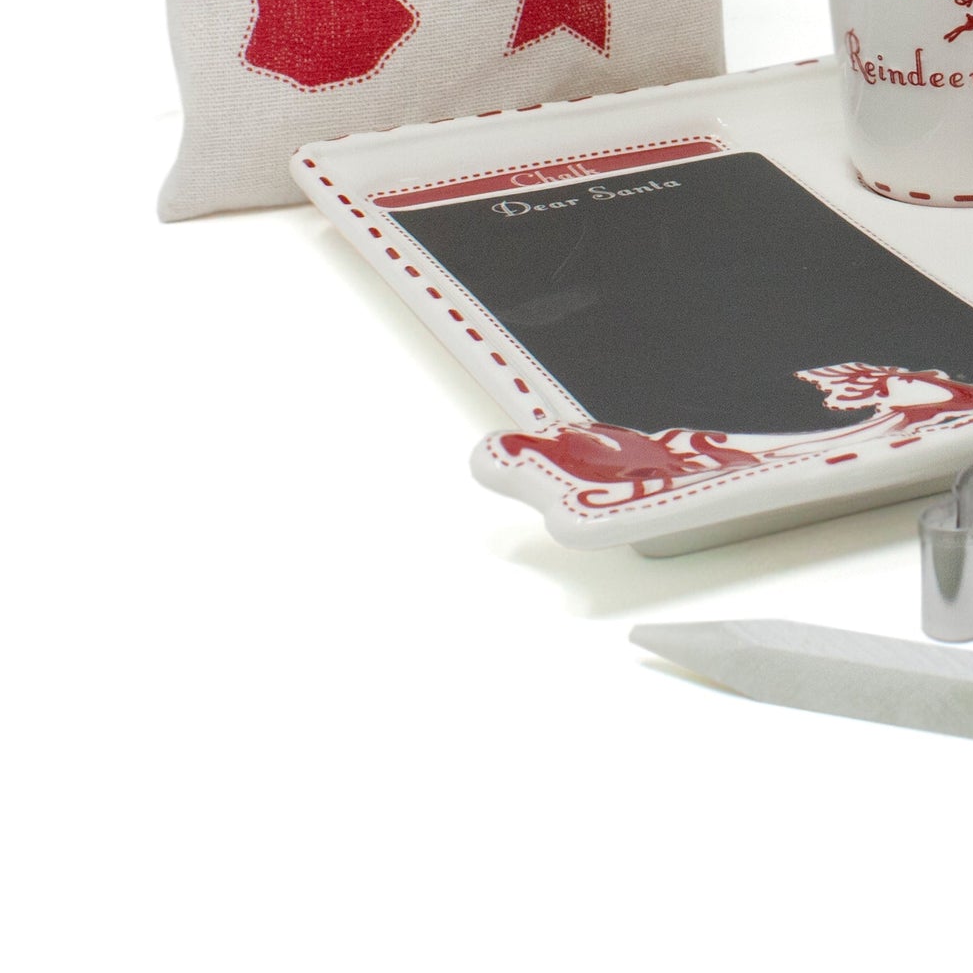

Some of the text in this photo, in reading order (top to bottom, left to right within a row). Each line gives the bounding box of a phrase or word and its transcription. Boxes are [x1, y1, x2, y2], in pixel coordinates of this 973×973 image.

[510, 163, 598, 187] Chalk
[491, 178, 682, 218] Dear Santa
